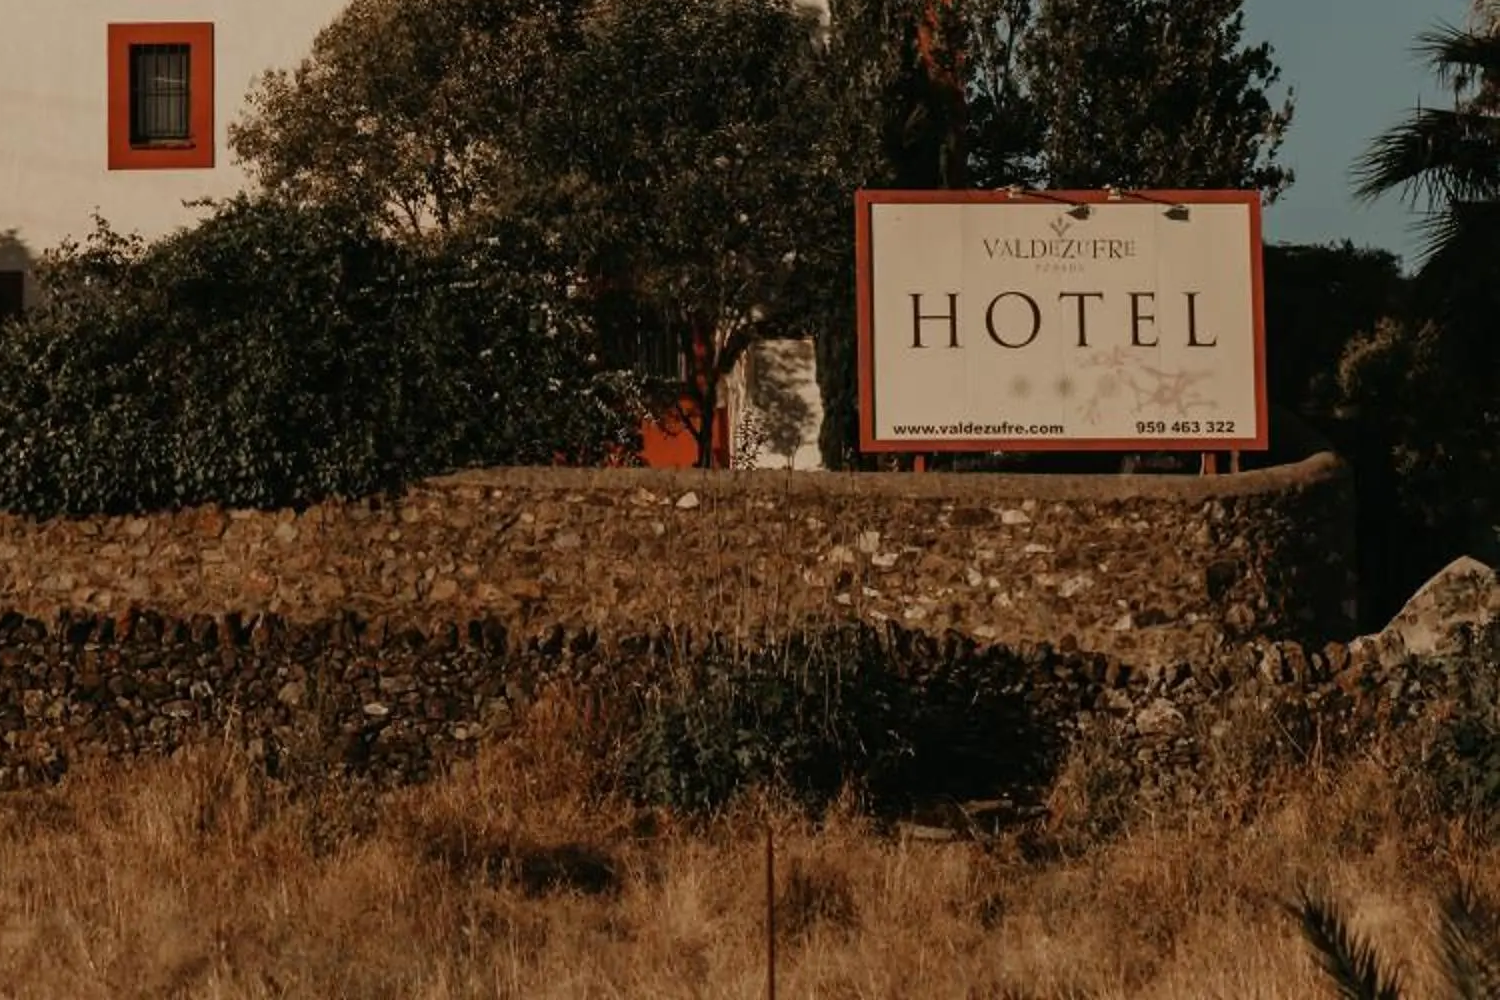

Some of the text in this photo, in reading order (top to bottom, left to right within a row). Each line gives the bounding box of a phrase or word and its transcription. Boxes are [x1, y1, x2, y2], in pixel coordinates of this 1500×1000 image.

[982, 238, 1137, 259] VALDEZUFRE
[908, 291, 1218, 349] HOTEL
[893, 421, 1065, 436] www.valdezufre.com
[1136, 421, 1236, 434] 959 463 322
